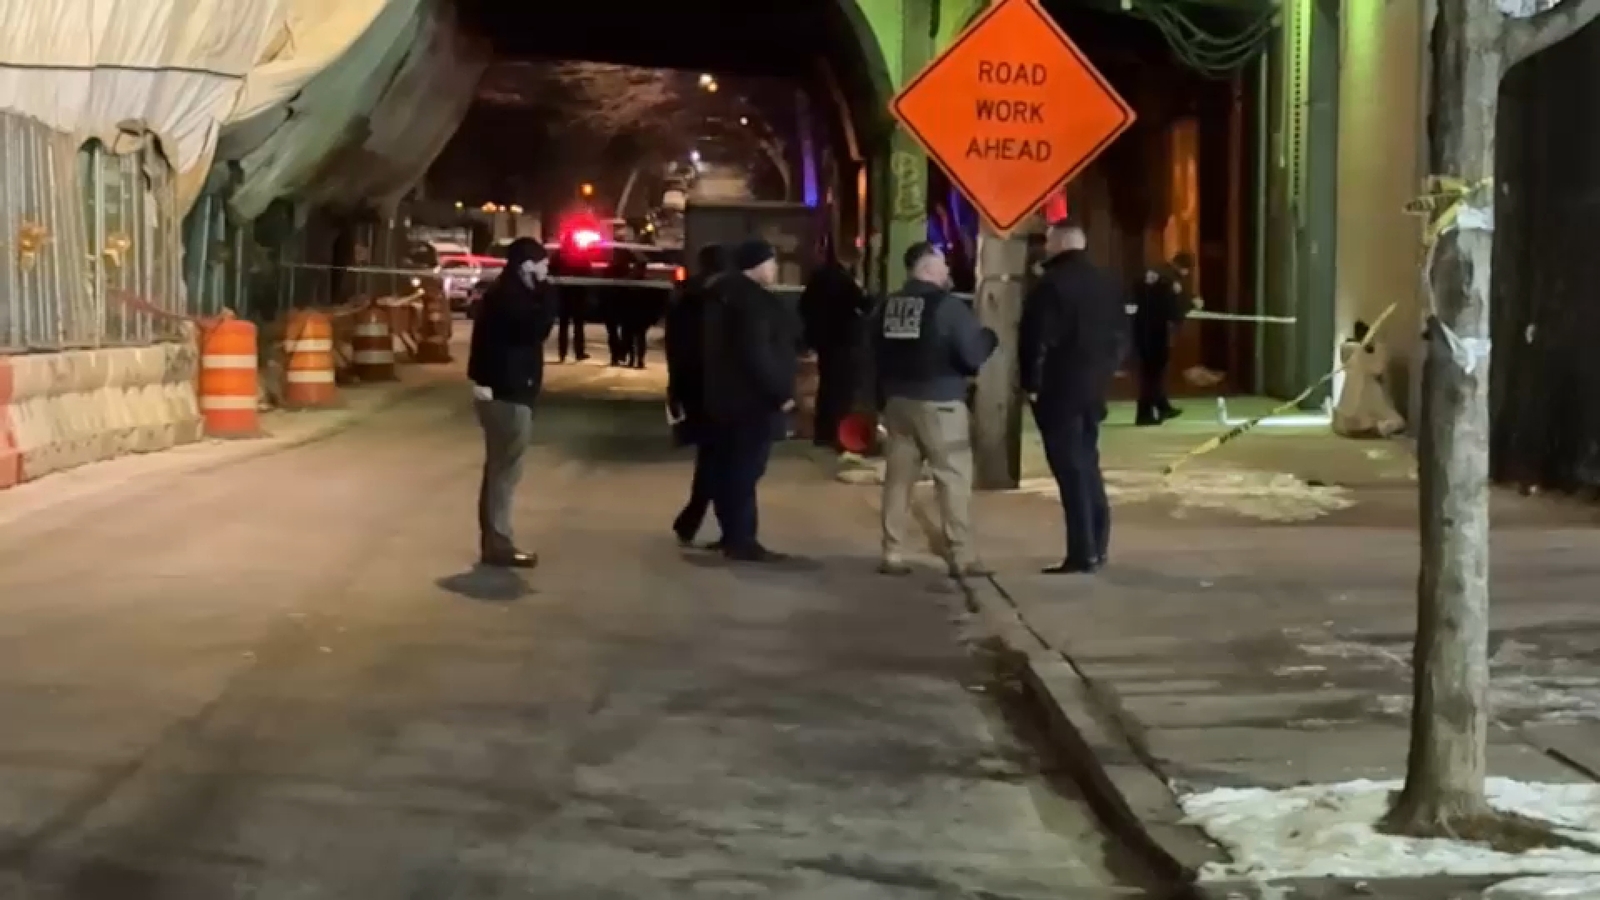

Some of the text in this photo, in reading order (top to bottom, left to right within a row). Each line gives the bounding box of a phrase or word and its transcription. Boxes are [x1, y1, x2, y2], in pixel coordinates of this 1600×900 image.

[978, 60, 1047, 86] ROAD
[976, 98, 1044, 124] WORK
[965, 136, 1052, 162] AHEAD
